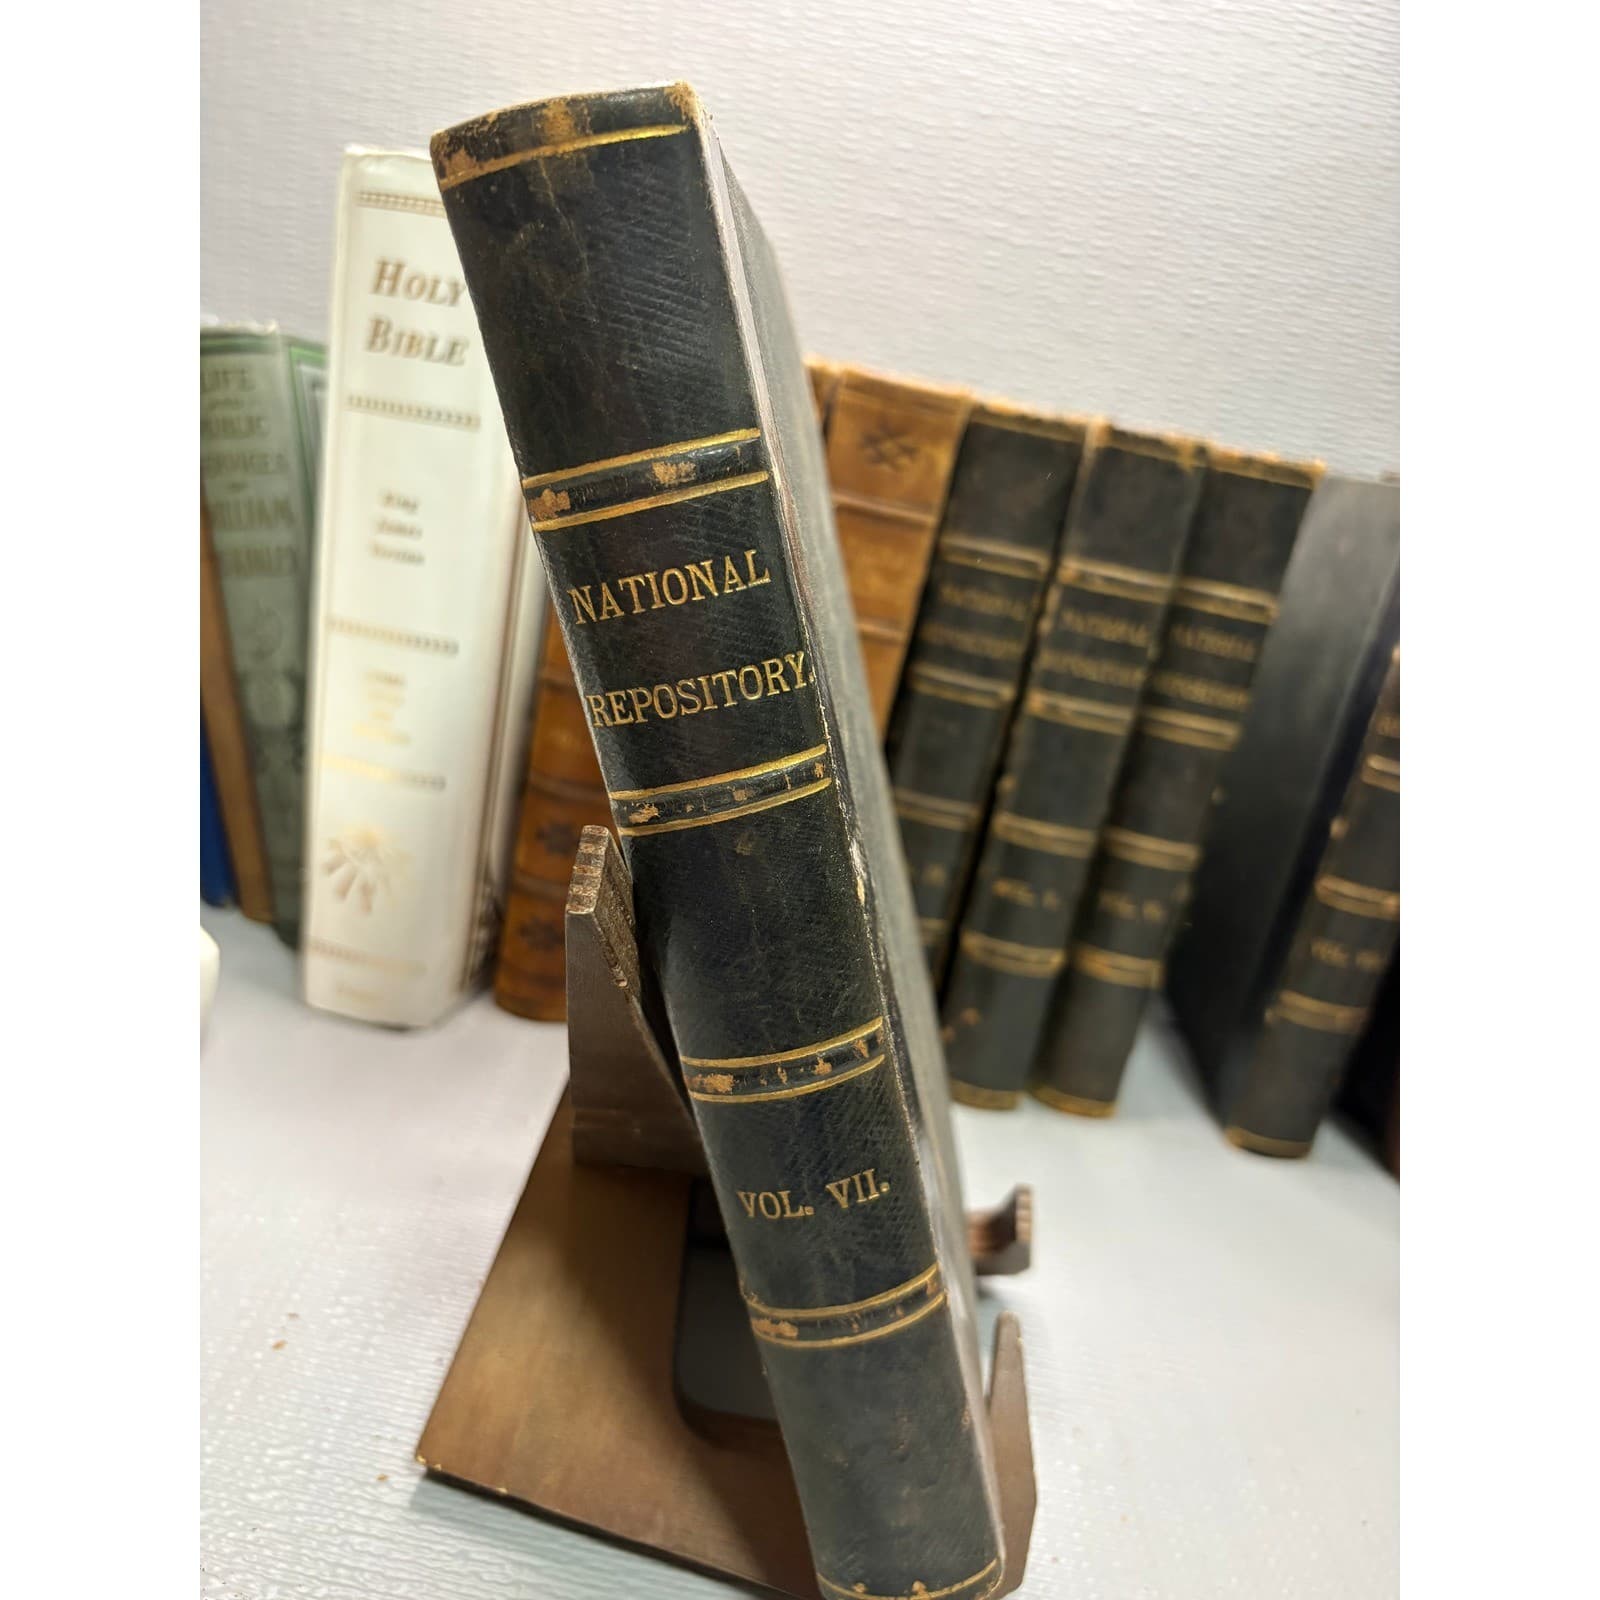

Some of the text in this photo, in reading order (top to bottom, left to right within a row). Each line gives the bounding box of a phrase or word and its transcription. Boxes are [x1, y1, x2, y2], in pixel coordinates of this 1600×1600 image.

[369, 257, 465, 307] HOLY
[364, 314, 469, 367] BIBLE
[566, 549, 771, 625] NATIONAL
[585, 650, 815, 728] REPOSITORY.
[737, 1168, 890, 1219] VOL. VII.
